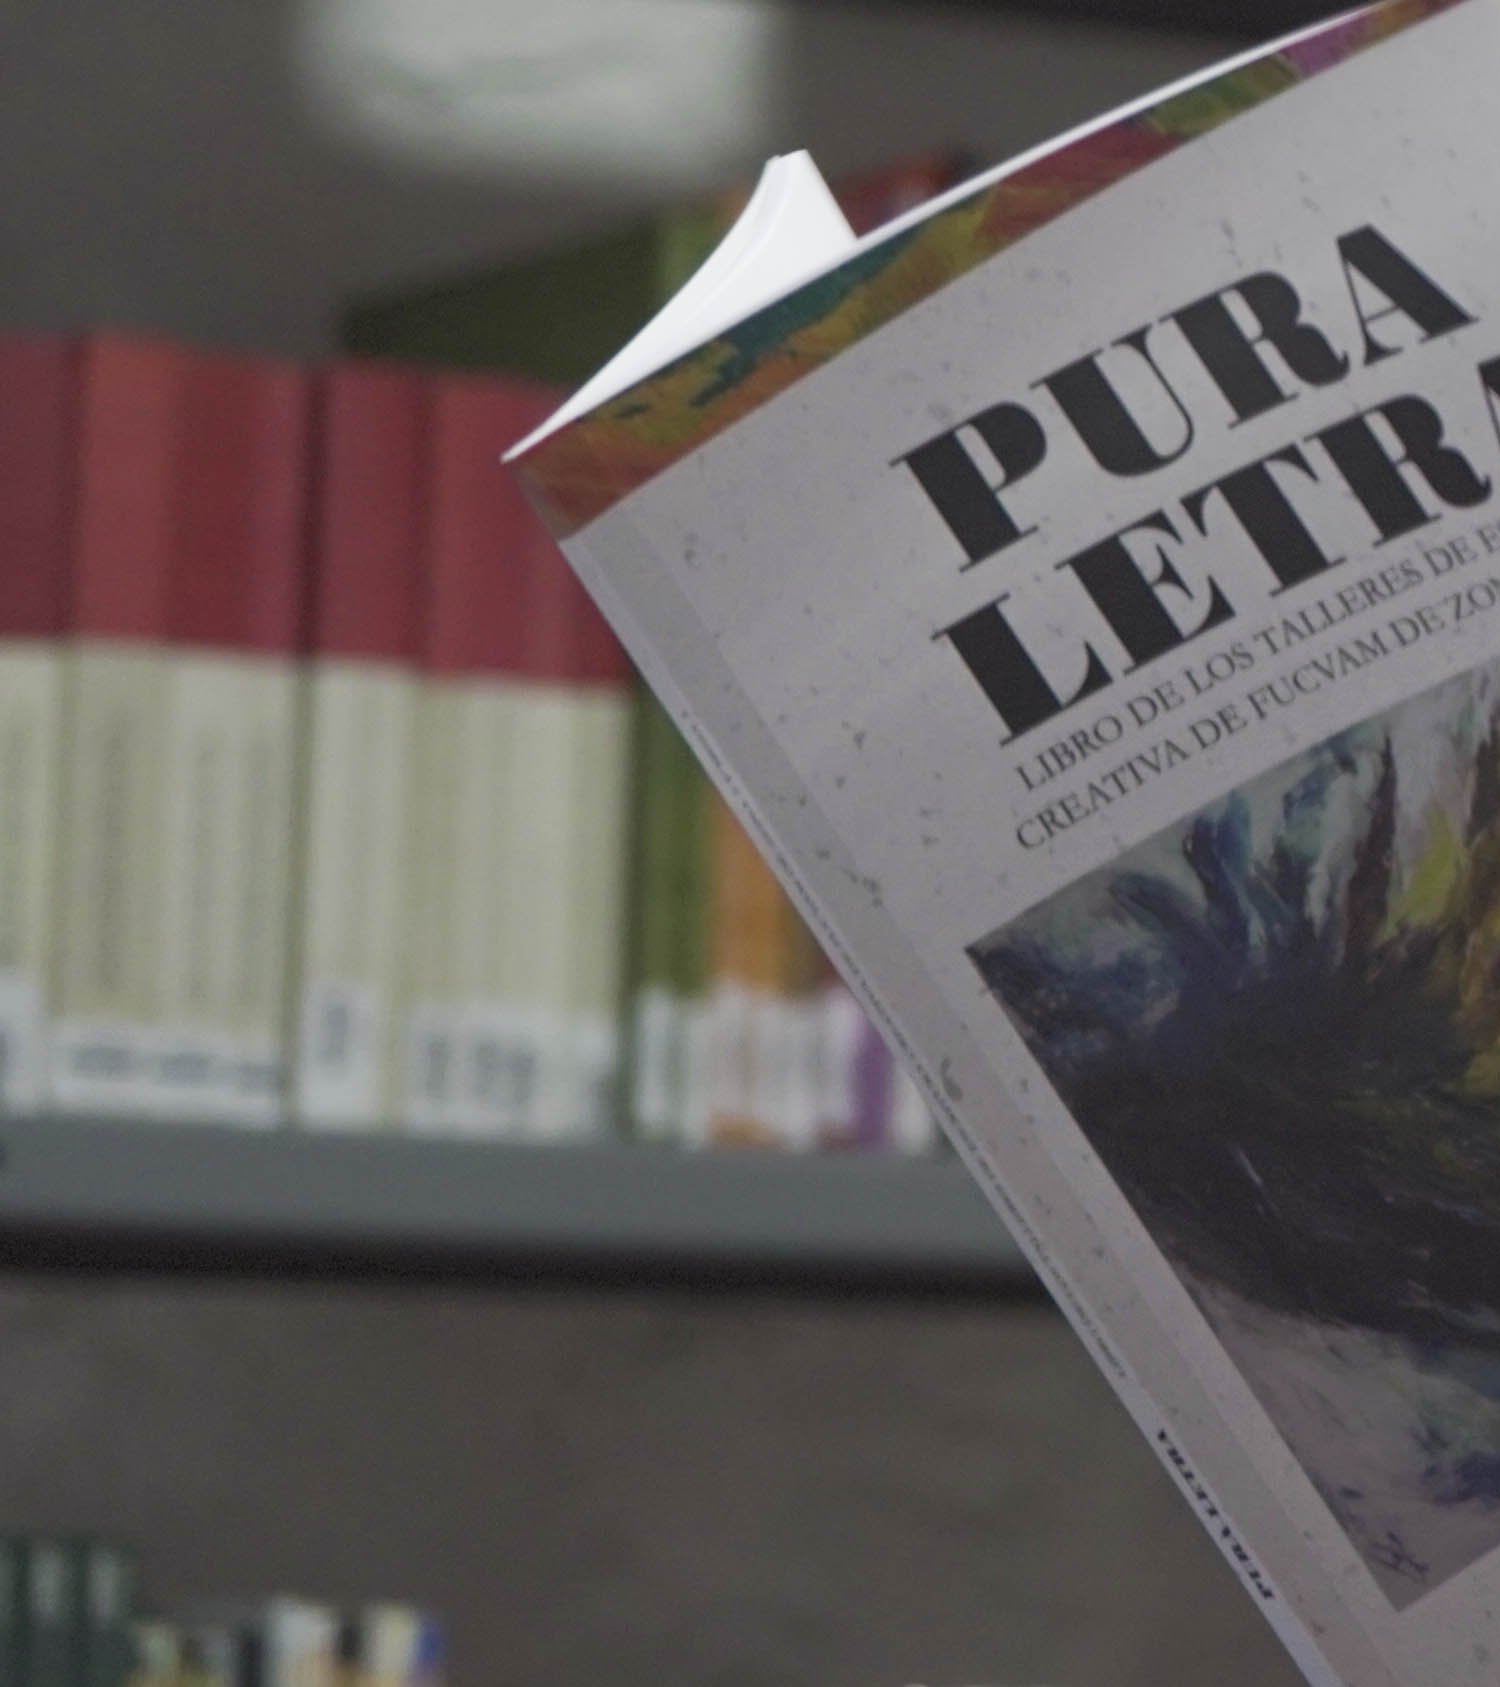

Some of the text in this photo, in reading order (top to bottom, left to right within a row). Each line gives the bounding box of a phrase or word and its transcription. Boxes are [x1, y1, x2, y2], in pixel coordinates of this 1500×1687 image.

[889, 223, 1481, 573] PURA
[1013, 712, 1125, 793] LIBRO
[1129, 679, 1181, 729] DE
[1185, 646, 1257, 703] LOS
[1253, 558, 1424, 656] TALLERES
[1422, 535, 1480, 578] DE
[1015, 741, 1191, 851] CREATIVA
[1191, 705, 1251, 752] DE
[1248, 631, 1389, 722] FUCVAM
[1388, 606, 1447, 650] DE
